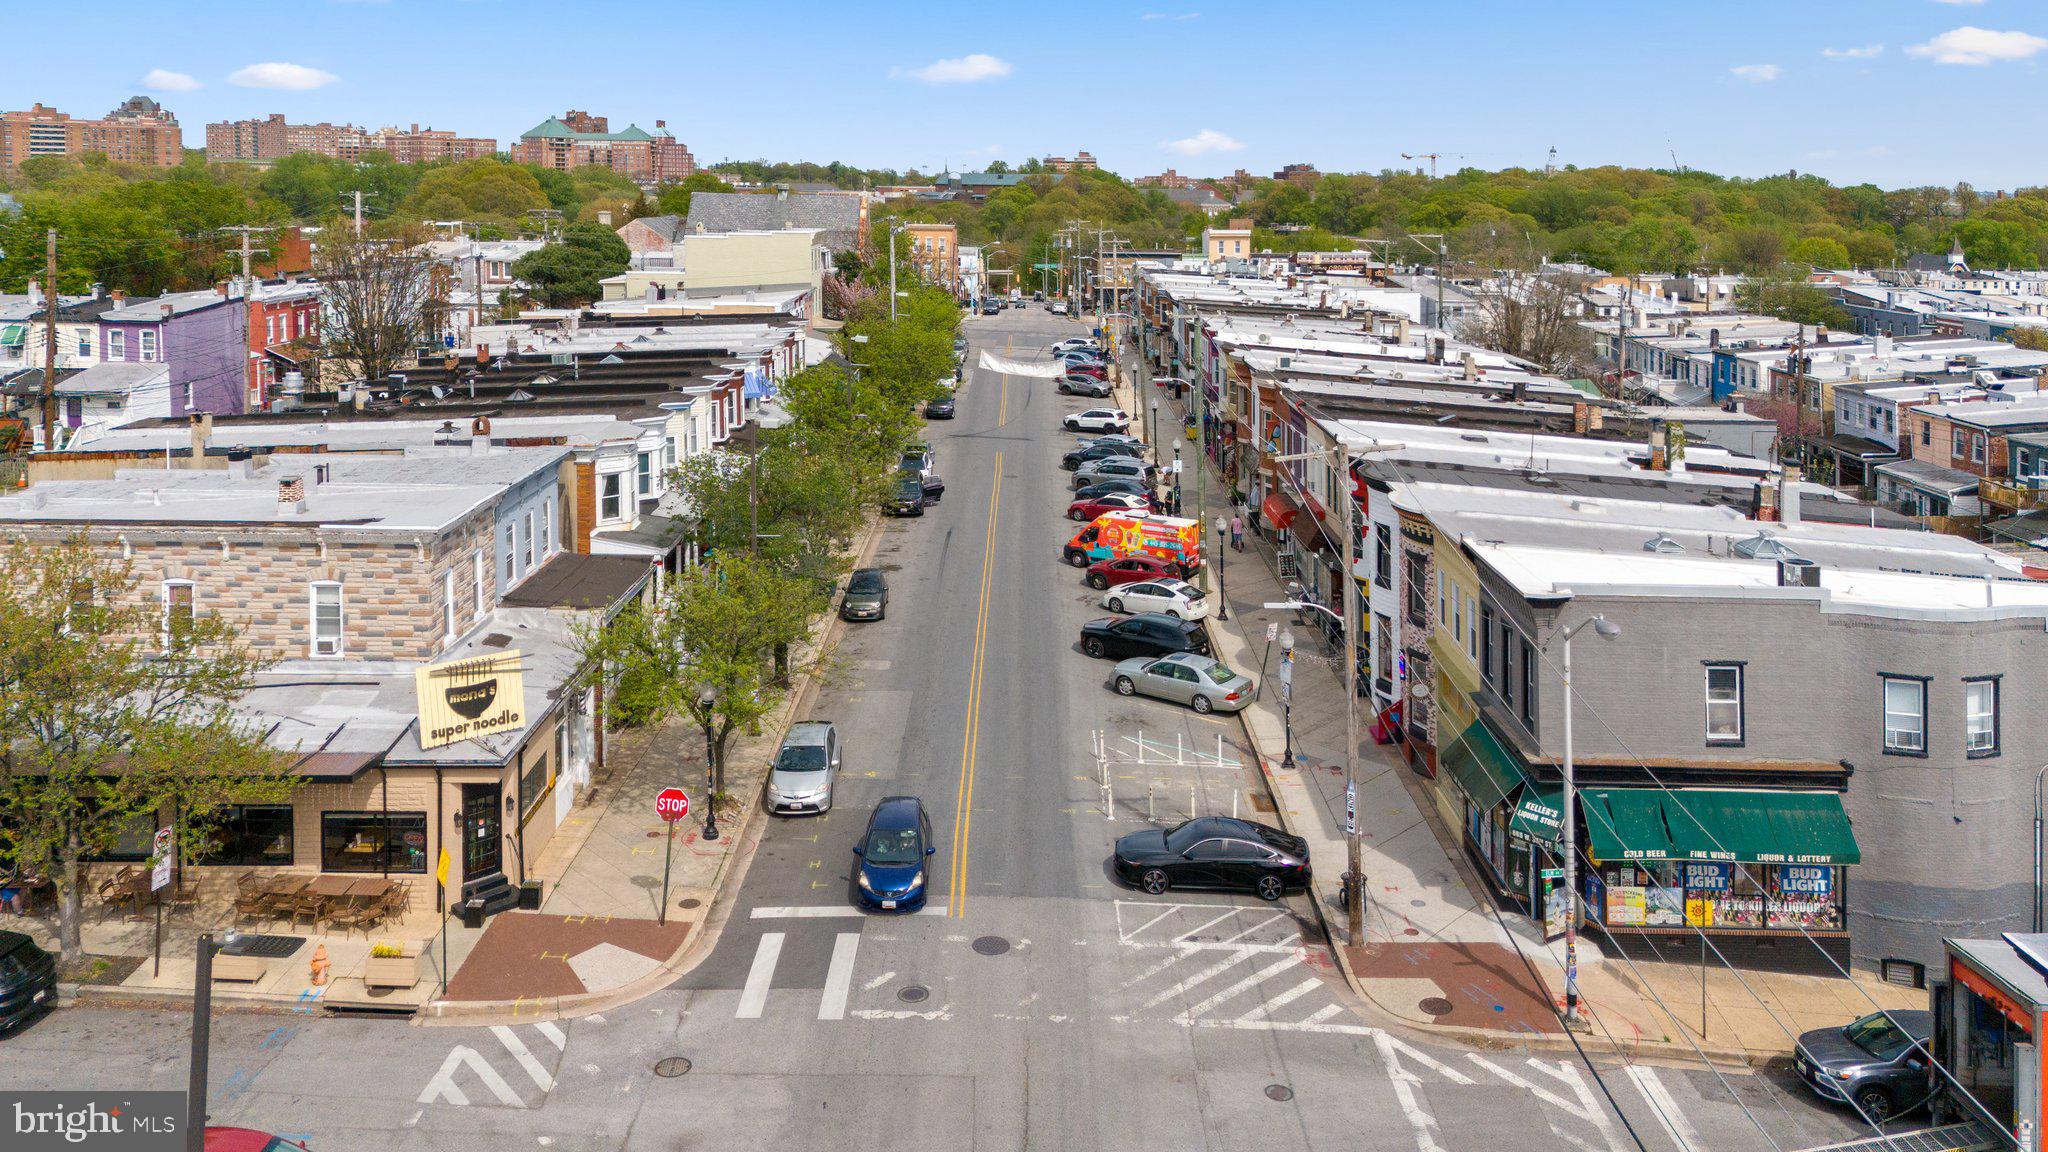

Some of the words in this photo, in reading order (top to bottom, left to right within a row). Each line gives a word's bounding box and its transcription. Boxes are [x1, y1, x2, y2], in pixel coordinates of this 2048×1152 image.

[449, 685, 496, 704] mona's
[431, 722, 470, 742] super
[473, 709, 519, 730] noodle
[658, 797, 687, 812] STOP
[1525, 801, 1558, 818] KELLER'S
[1517, 809, 1539, 822] LIQUOR
[1539, 816, 1560, 828] STORE
[1624, 850, 1644, 858] COLD
[1646, 850, 1667, 858] BEER
[1690, 850, 1707, 859] FINE
[1710, 851, 1736, 860] WINES
[1757, 853, 1785, 862] LIQUOR
[1787, 854, 1794, 862] &
[1797, 855, 1831, 863] LOTTERY
[1687, 865, 1720, 876] BUD
[1789, 867, 1822, 879] BUD
[1686, 877, 1726, 888] IGHT
[1783, 880, 1828, 891] LIGHT
